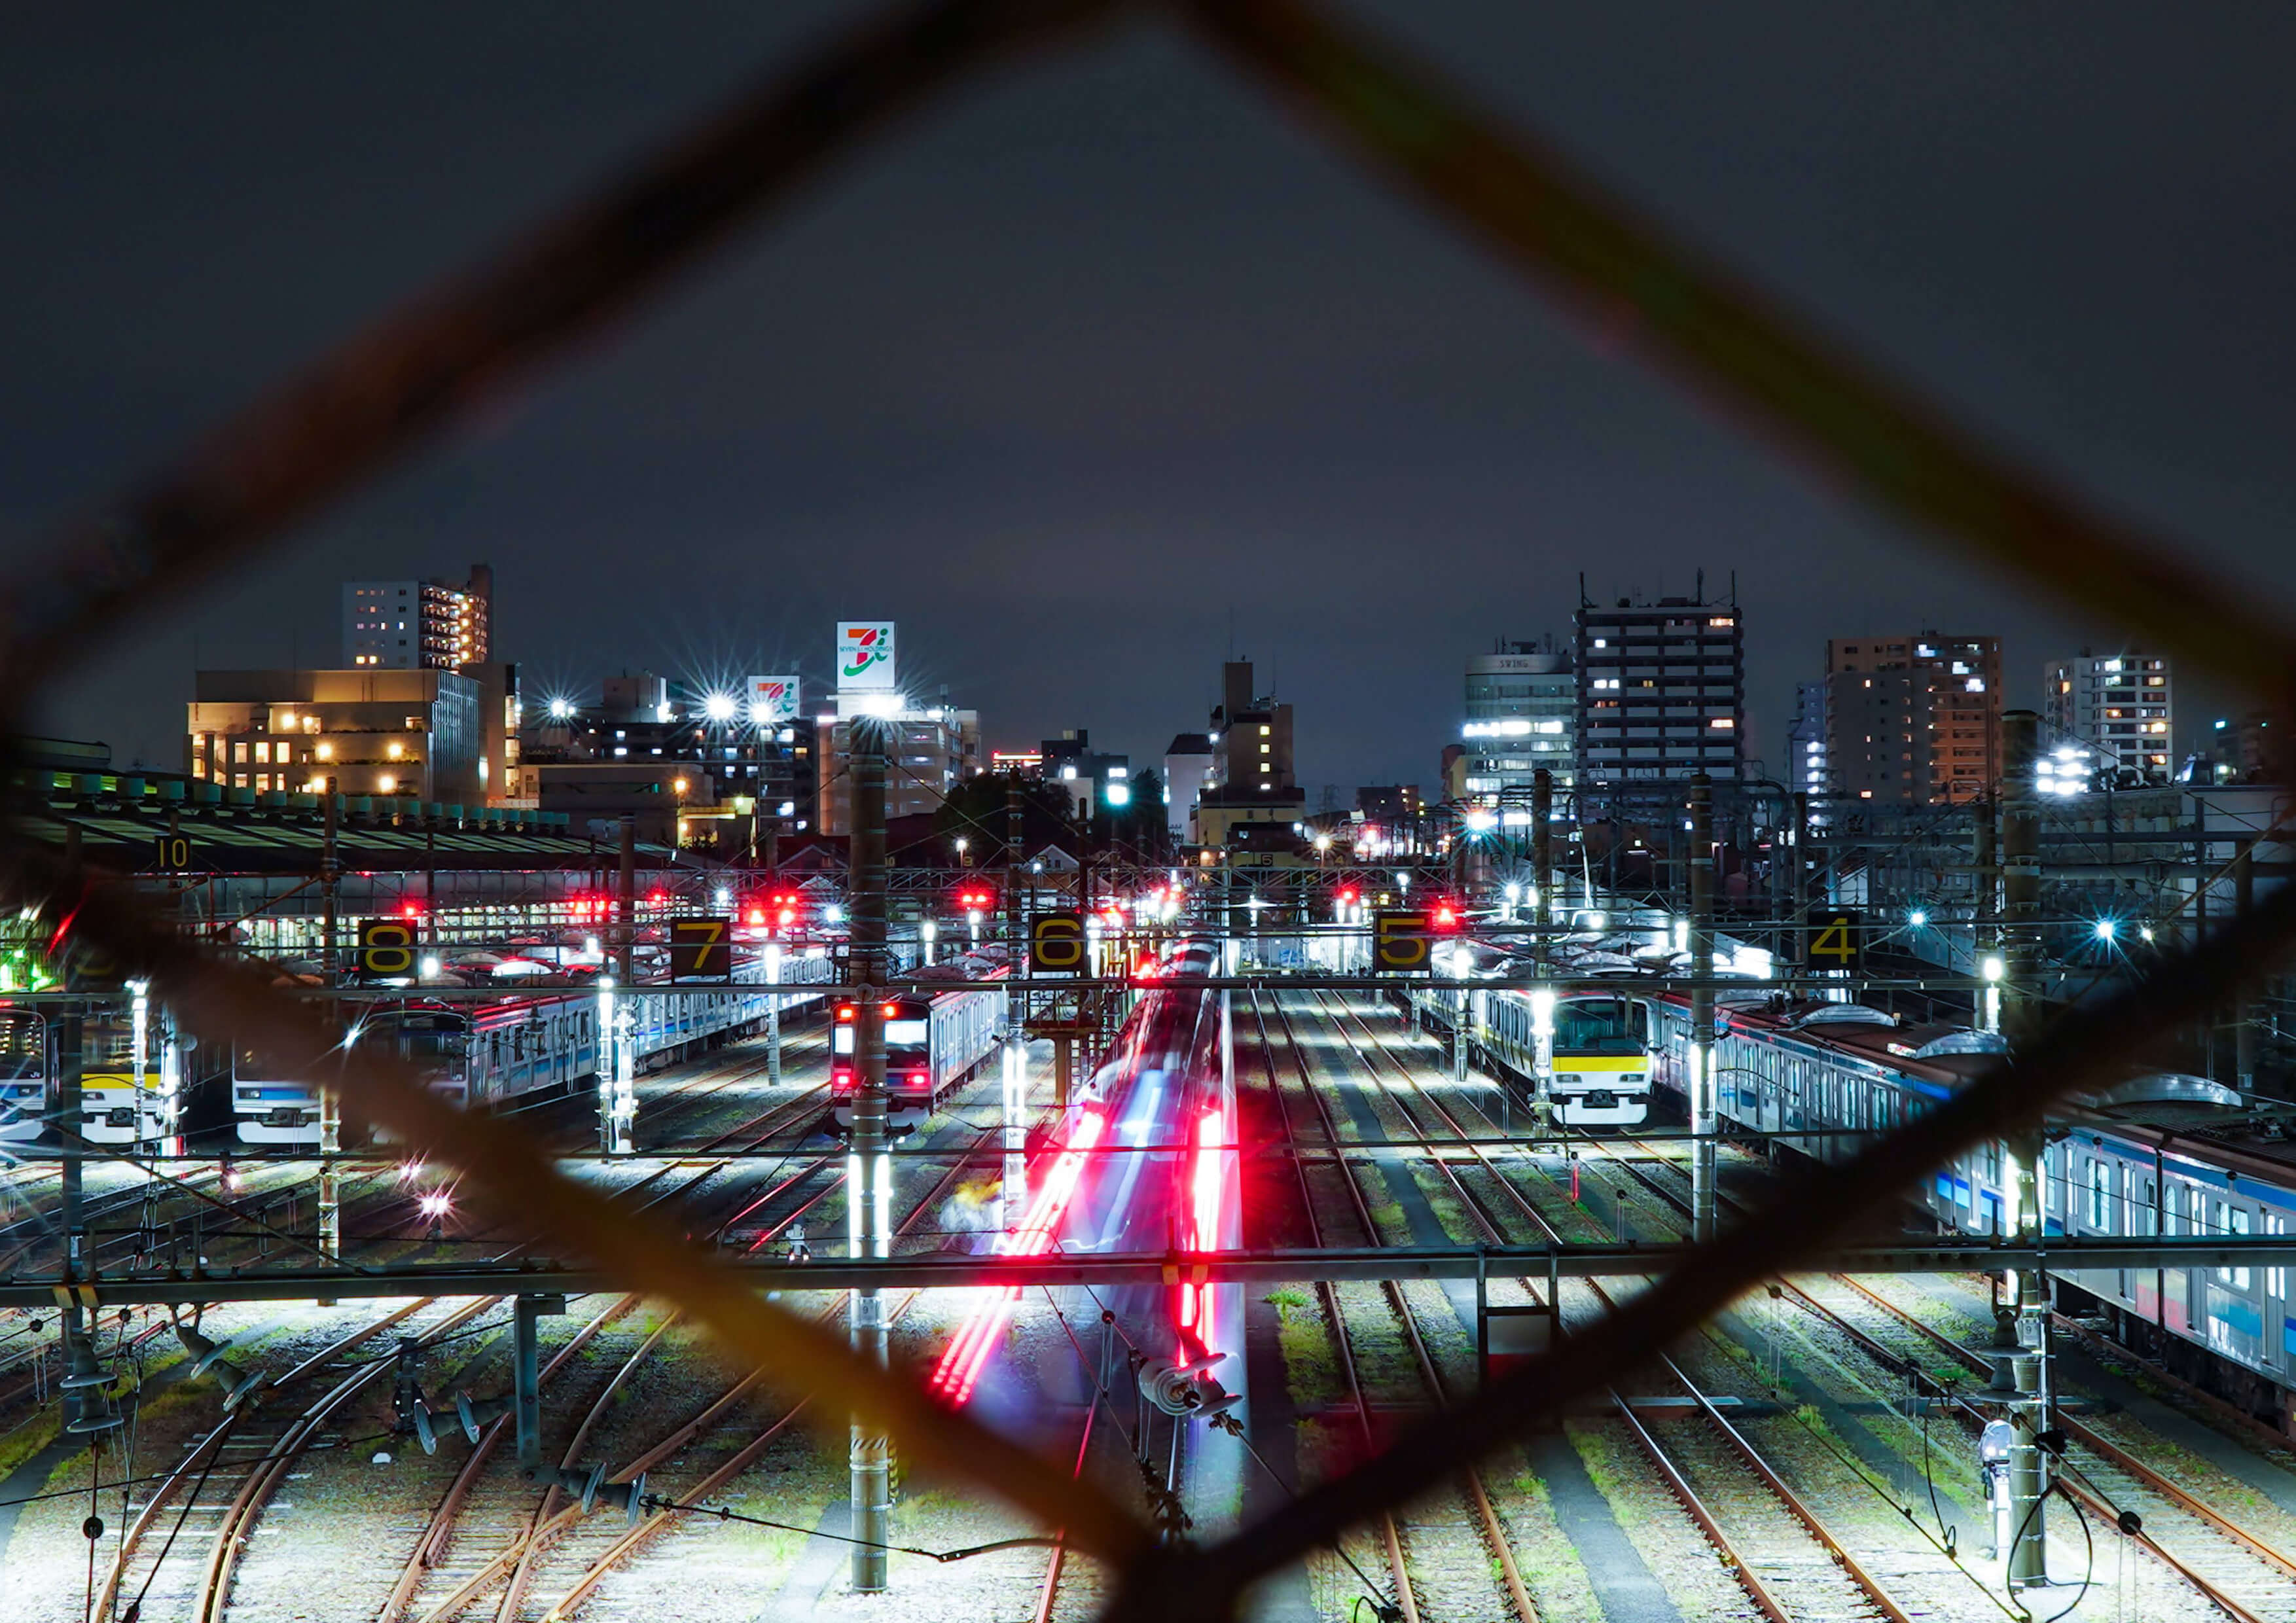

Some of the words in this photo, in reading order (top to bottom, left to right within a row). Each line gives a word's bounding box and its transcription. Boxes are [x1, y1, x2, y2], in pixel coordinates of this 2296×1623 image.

[1498, 659, 1529, 669] SWING
[158, 837, 188, 868] 10
[749, 858, 759, 868] 12
[1492, 854, 1501, 864] 2
[365, 925, 411, 972] 8
[677, 923, 724, 970] 7
[1035, 918, 1082, 965] 6
[1379, 918, 1426, 965] 5
[1810, 917, 1857, 964] 4
[863, 1306, 869, 1314] 9
[2026, 1326, 2032, 1334] 9
